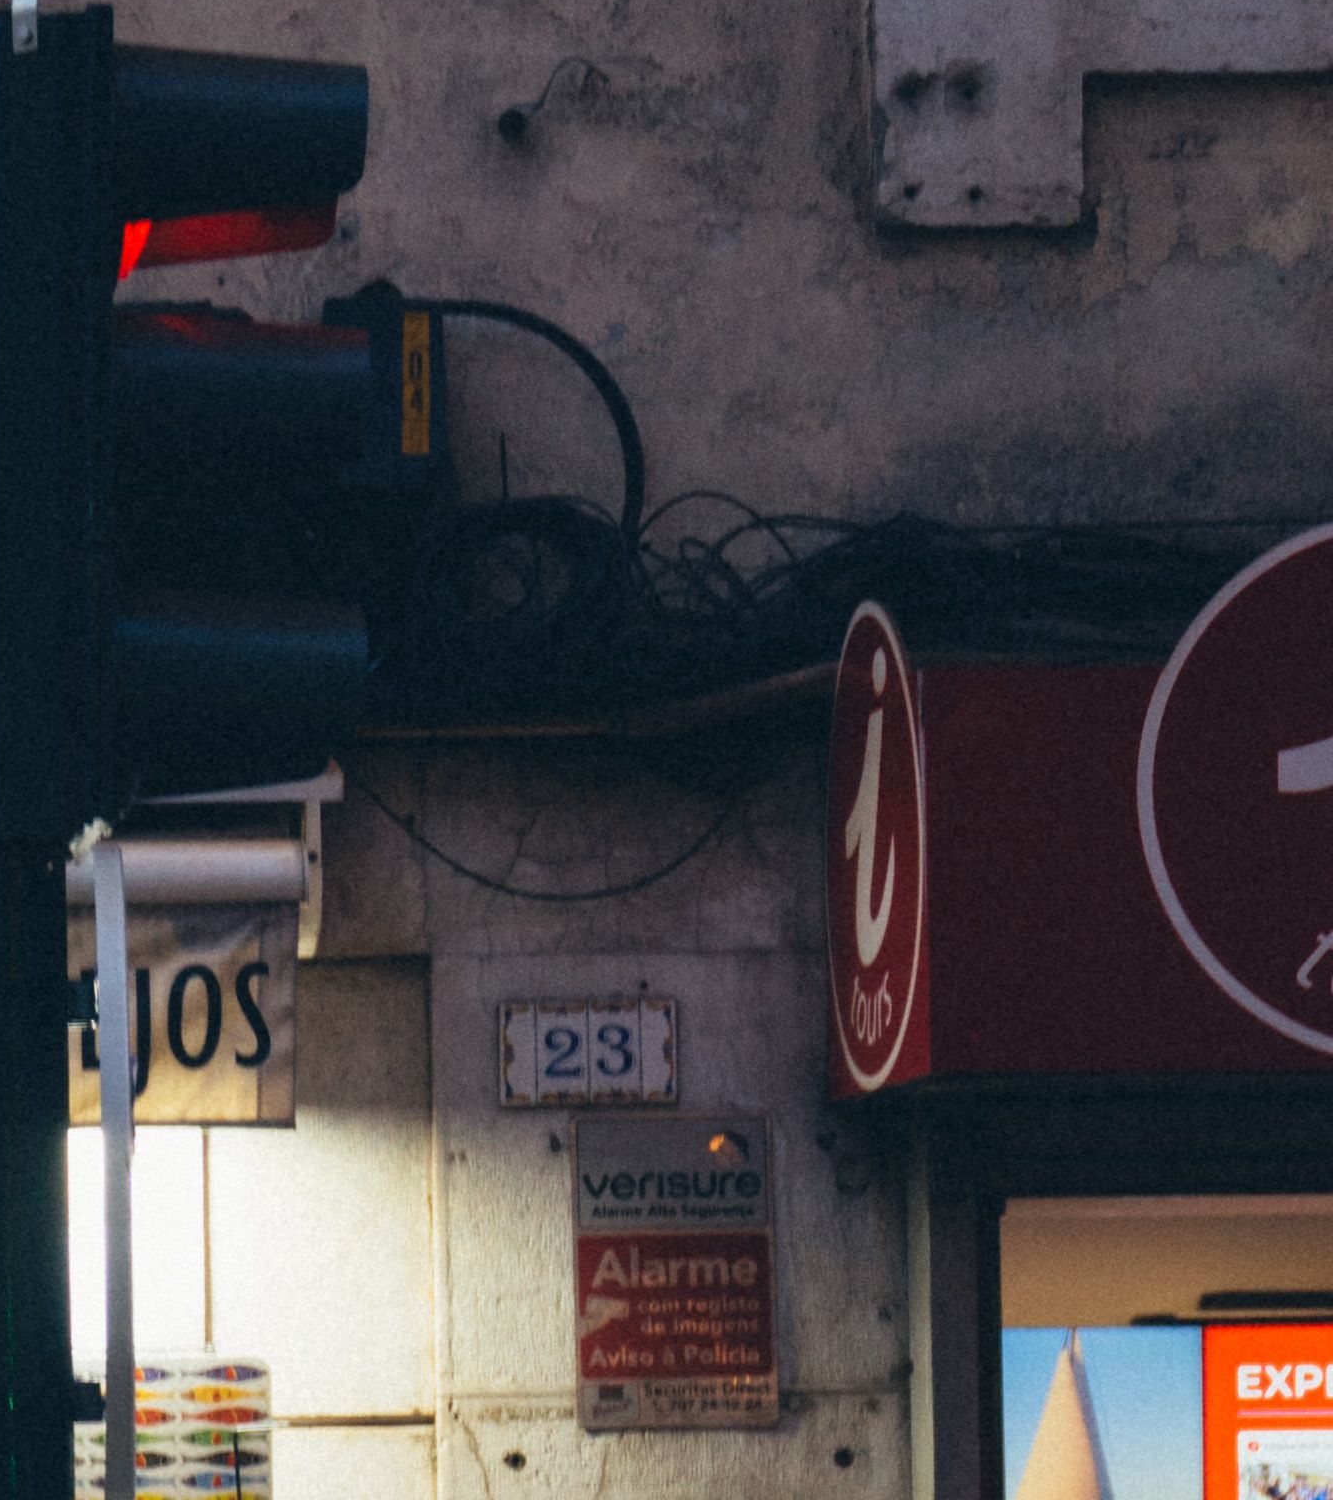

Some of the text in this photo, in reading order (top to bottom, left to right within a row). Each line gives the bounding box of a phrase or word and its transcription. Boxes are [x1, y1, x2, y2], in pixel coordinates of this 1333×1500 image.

[851, 971, 892, 1046] tours
[544, 1025, 634, 1079] 23
[583, 1169, 762, 1201] verisure
[592, 1246, 759, 1289] Alarme
[589, 1344, 655, 1368] Aviso
[1237, 1363, 1333, 1399] EXP
